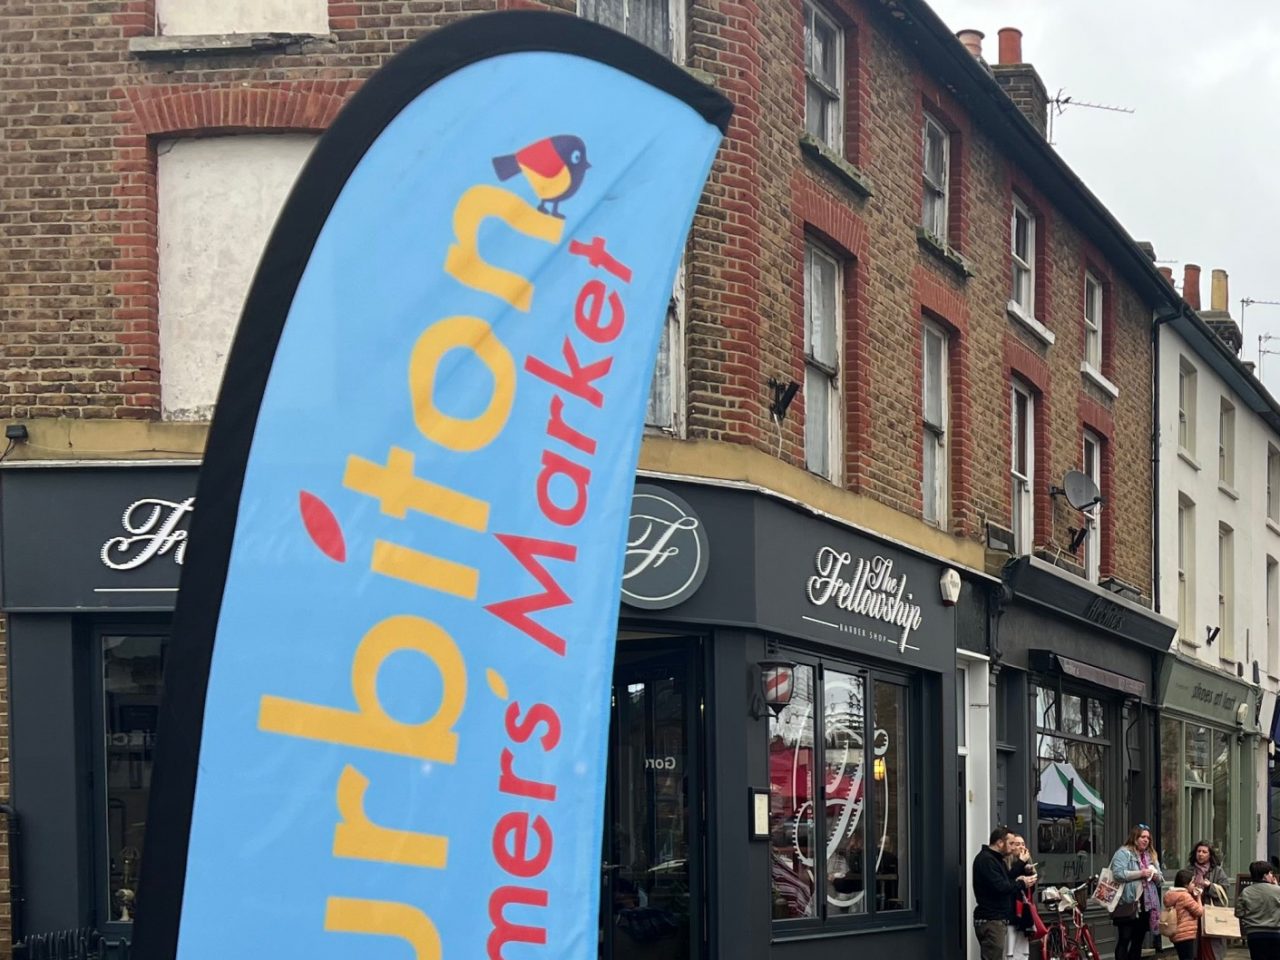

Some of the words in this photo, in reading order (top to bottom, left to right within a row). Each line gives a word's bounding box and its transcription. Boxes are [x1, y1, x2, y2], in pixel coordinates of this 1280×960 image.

[485, 234, 633, 656] Market
[807, 546, 923, 653] Fellowship
[867, 555, 898, 594] The
[869, 628, 888, 642] SHOP
